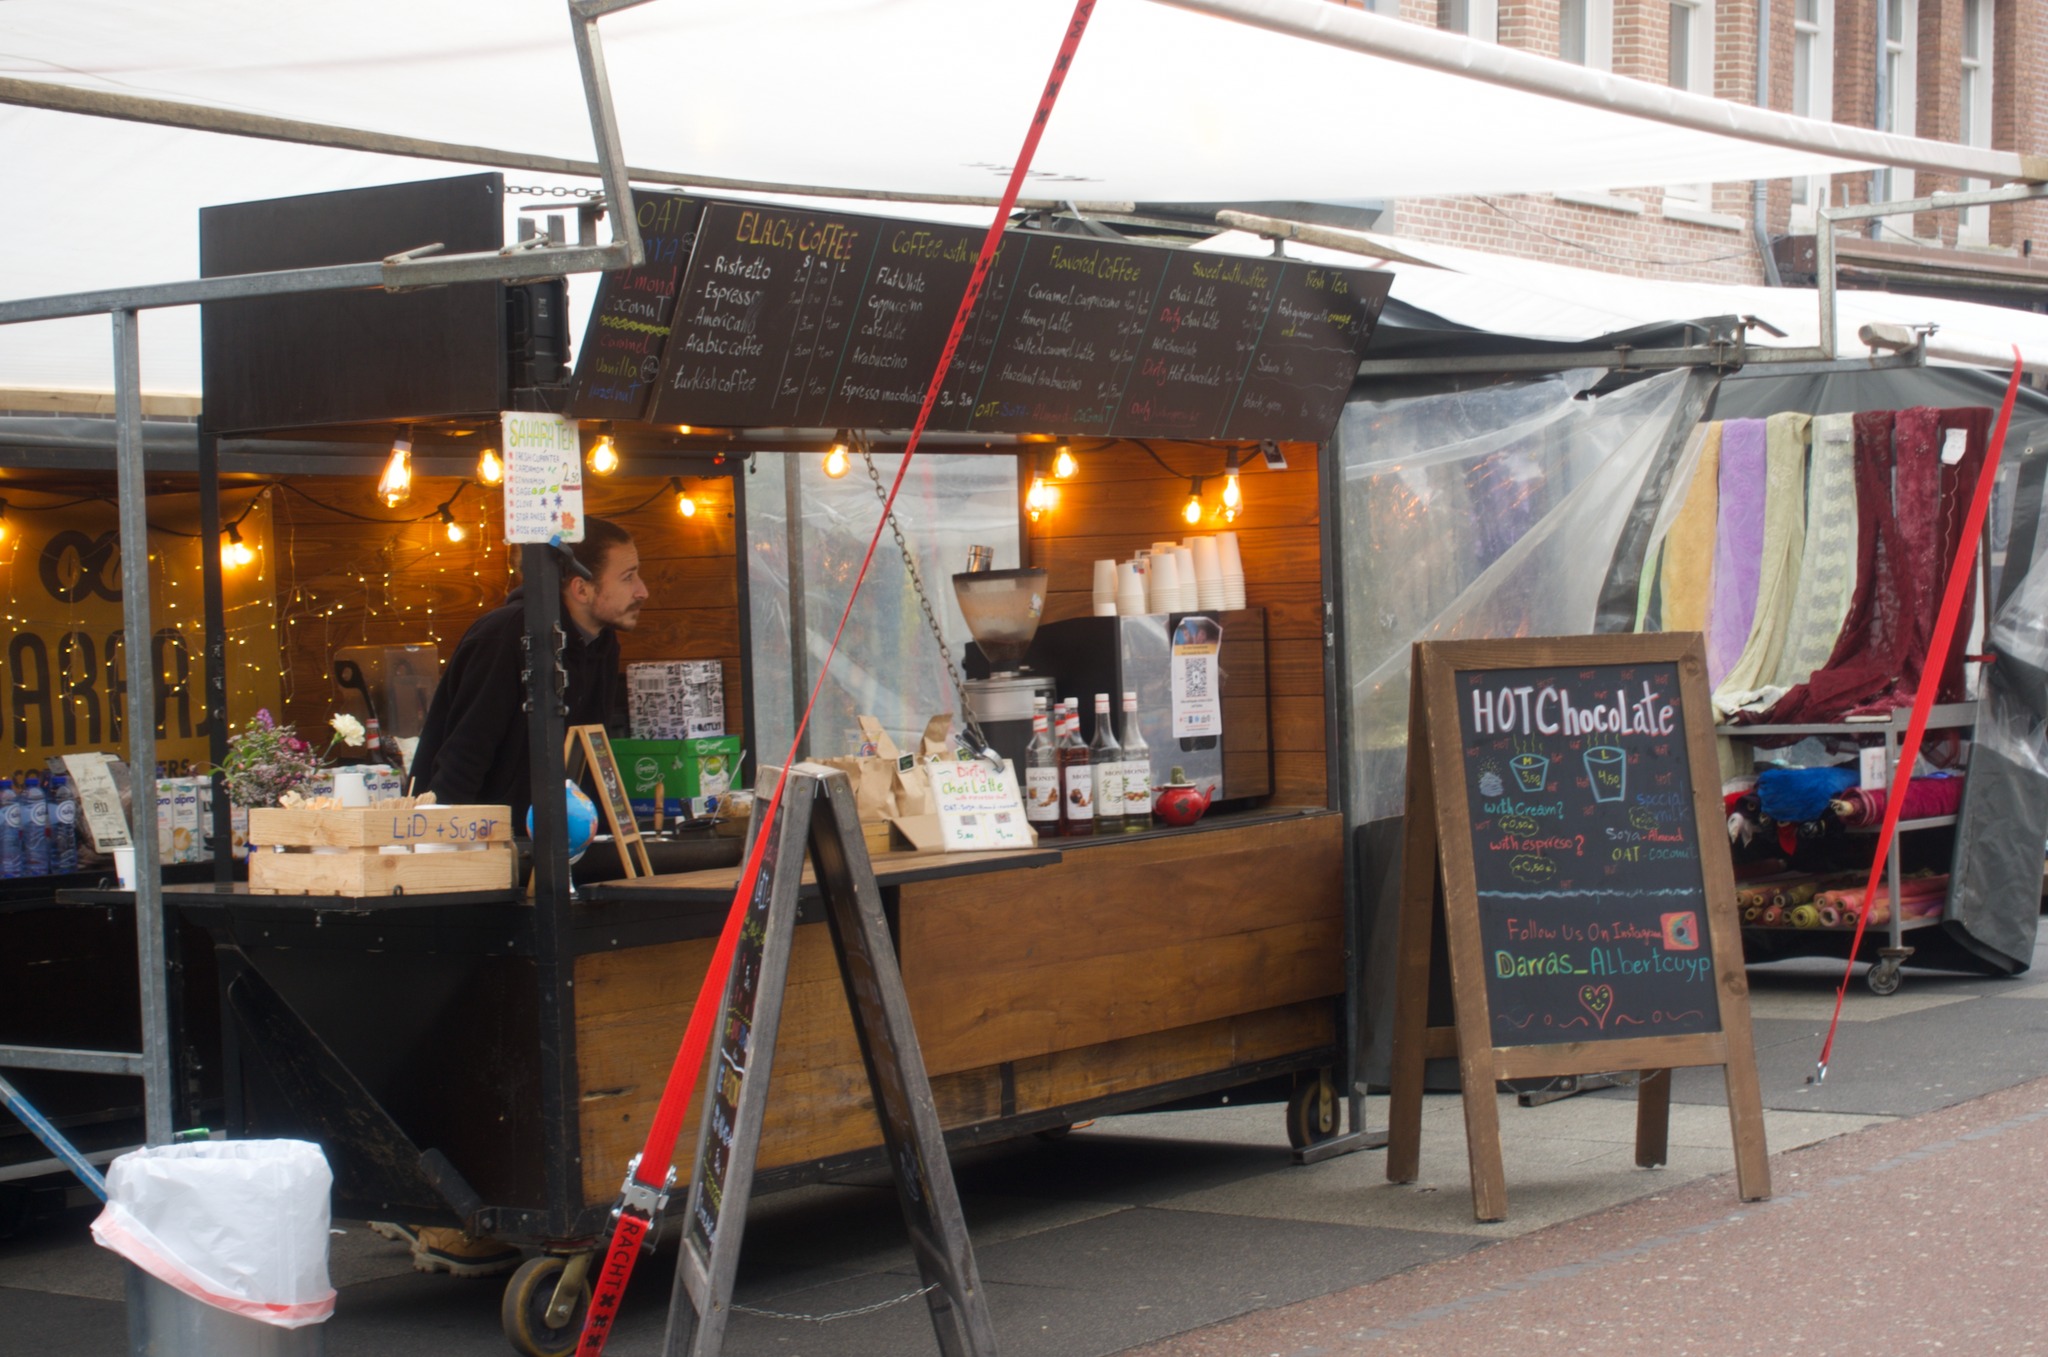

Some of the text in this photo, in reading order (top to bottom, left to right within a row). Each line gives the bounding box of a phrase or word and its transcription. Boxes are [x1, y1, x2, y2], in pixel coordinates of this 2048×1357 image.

[638, 198, 695, 233] OAT
[736, 210, 799, 250] BLACK
[714, 255, 772, 280] Ristretto
[1330, 271, 1349, 294] Tea
[704, 280, 766, 312] Espresso
[684, 330, 728, 356] Arabic
[728, 334, 764, 357] coffee
[717, 368, 757, 392] coffee
[1472, 686, 1534, 736] HOT
[174, 795, 196, 806] alpro
[1484, 797, 1513, 815] with
[450, 816, 498, 841] Sugar
[1490, 835, 1519, 851] with
[1507, 918, 1557, 941] Follow
[1562, 924, 1584, 941] Us
[1588, 923, 1610, 942] On
